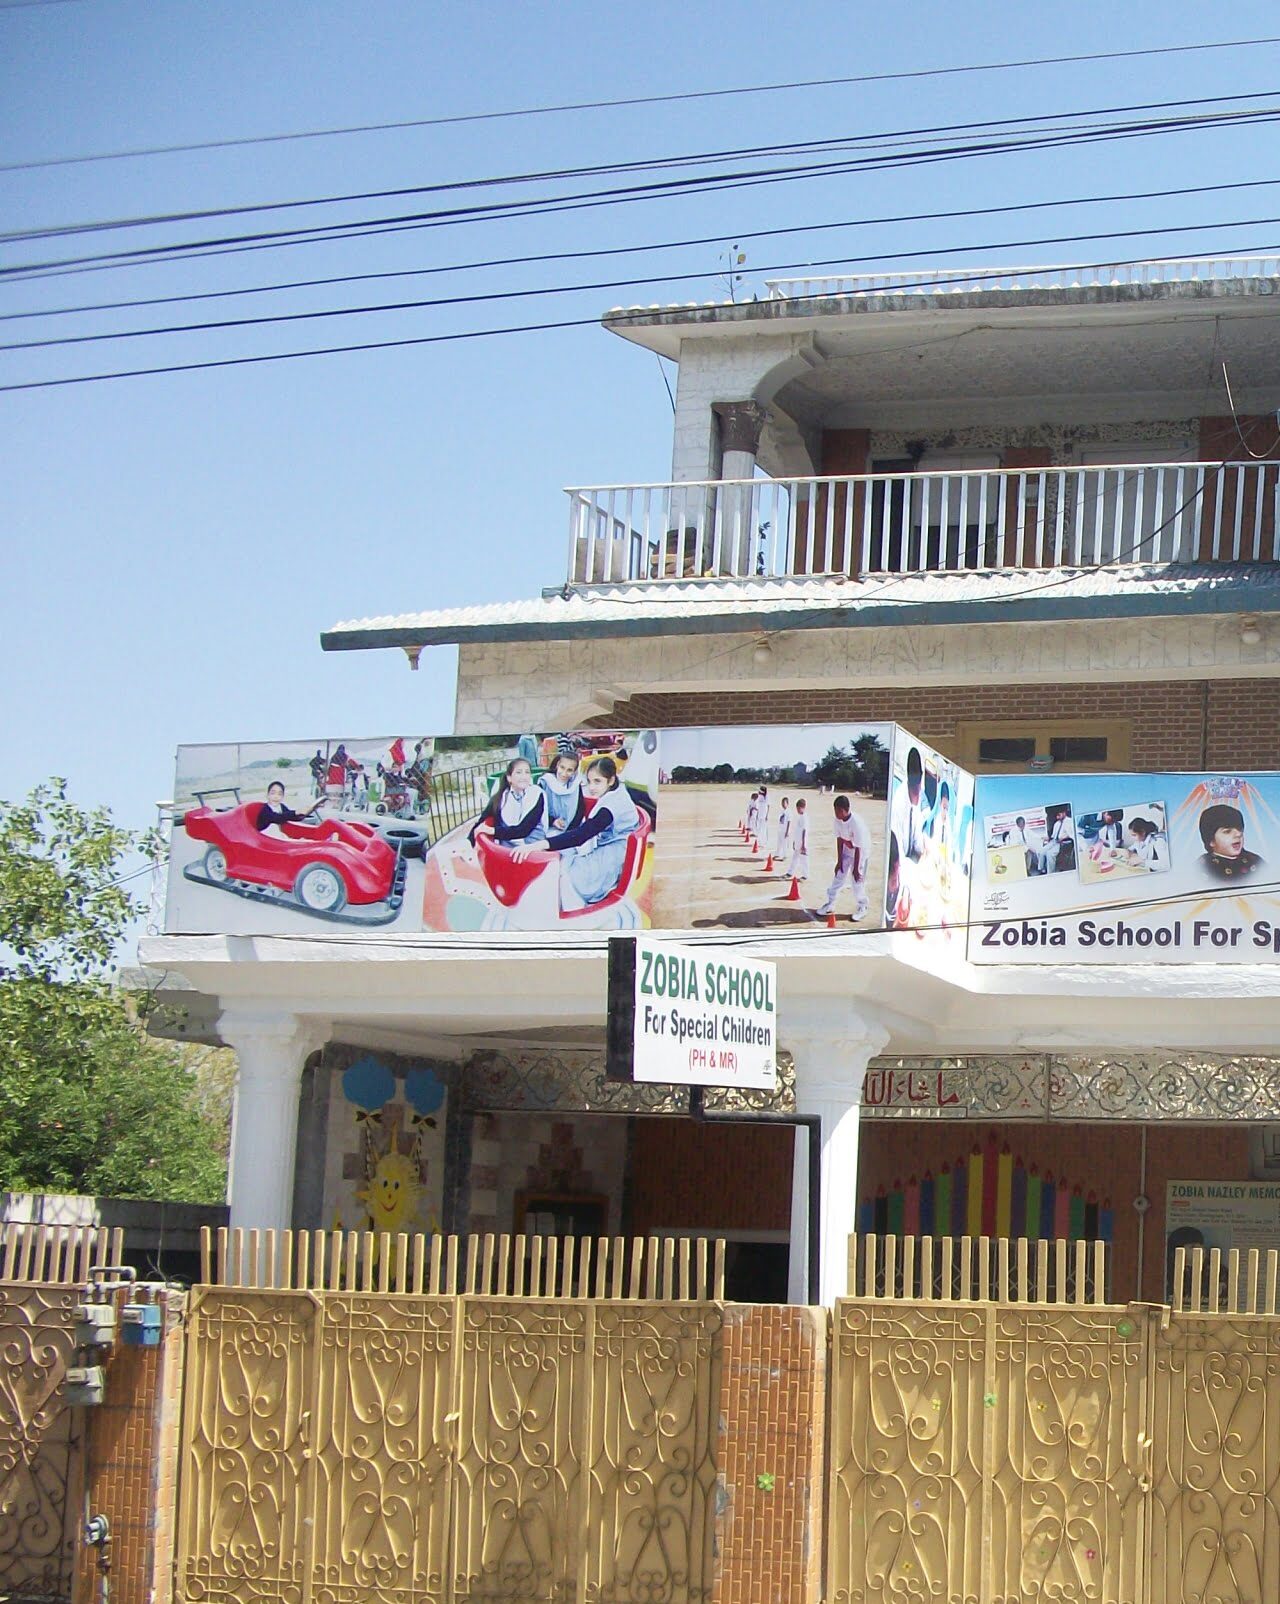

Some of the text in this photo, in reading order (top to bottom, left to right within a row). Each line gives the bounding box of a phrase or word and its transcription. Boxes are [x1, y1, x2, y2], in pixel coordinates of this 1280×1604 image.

[981, 921, 1066, 947] Zobia
[1077, 920, 1181, 947] School
[1193, 921, 1242, 946] For
[640, 951, 773, 1012] ZOBIA SCHOOL
[644, 1005, 771, 1047] For Special Children
[688, 1049, 706, 1071] (PH
[709, 1051, 716, 1068] &
[719, 1051, 738, 1074] MR)
[1171, 1185, 1204, 1199] ZOBIA
[1207, 1186, 1246, 1199] NAZLEY
